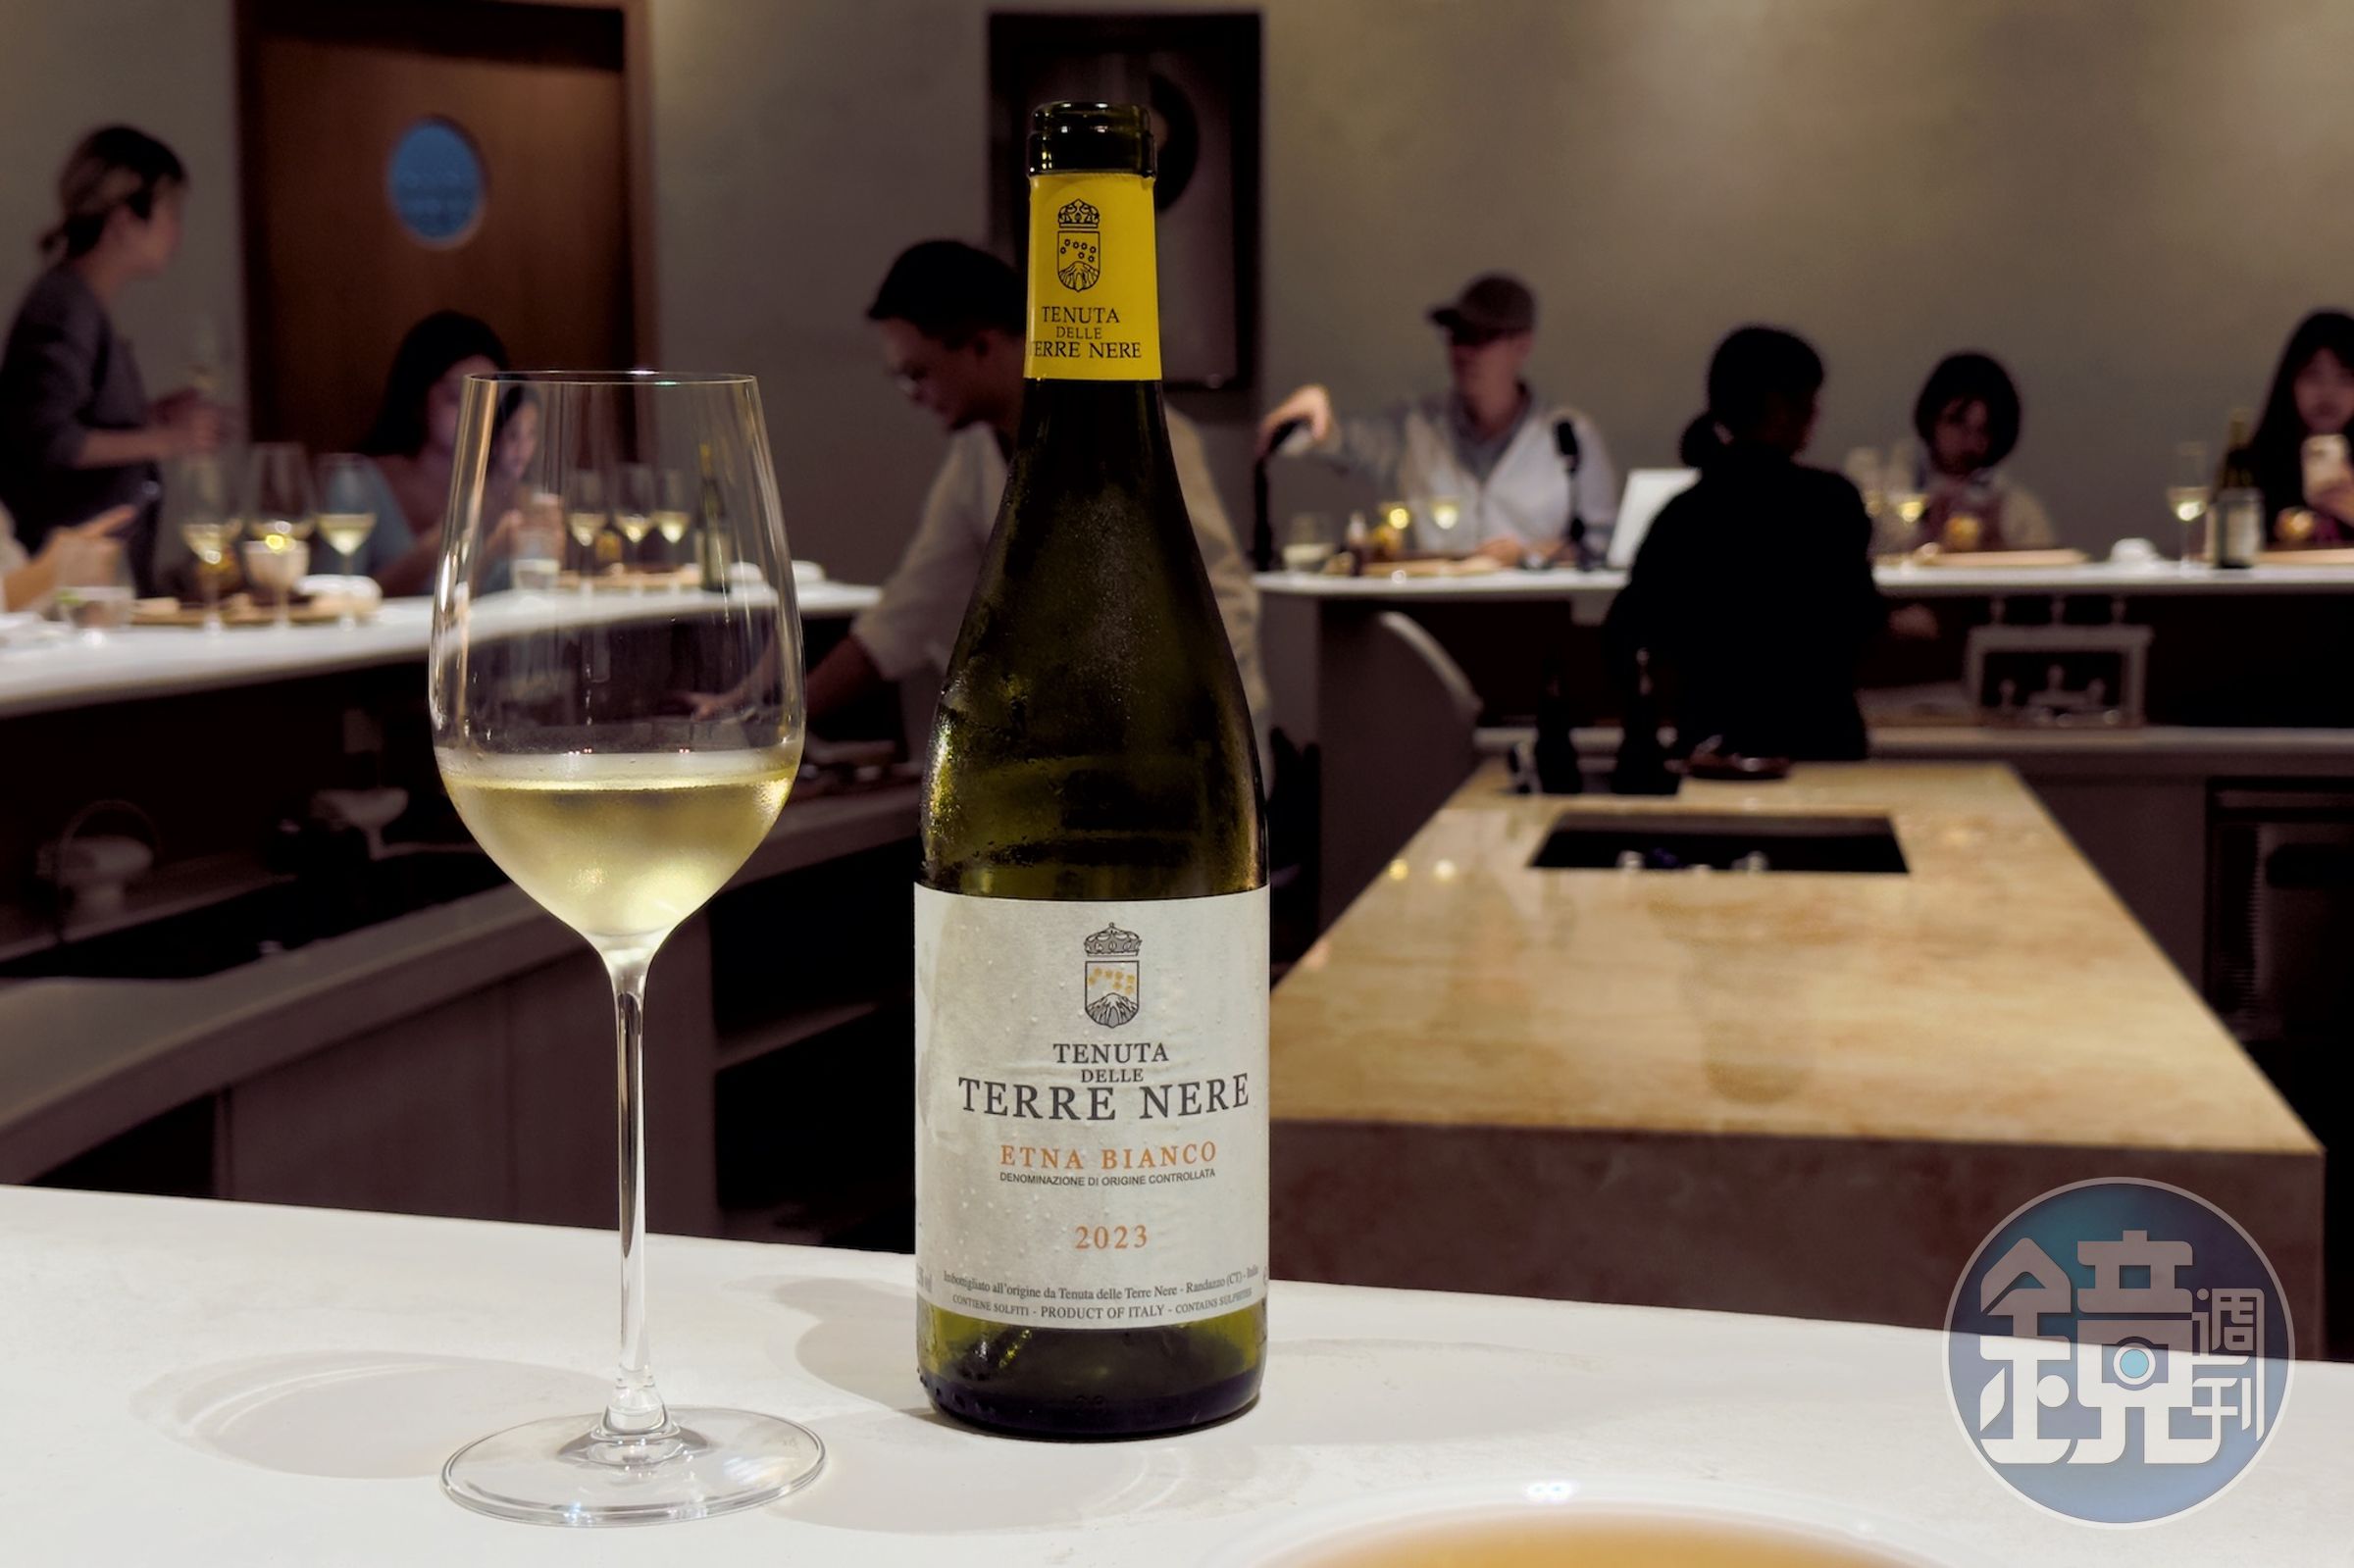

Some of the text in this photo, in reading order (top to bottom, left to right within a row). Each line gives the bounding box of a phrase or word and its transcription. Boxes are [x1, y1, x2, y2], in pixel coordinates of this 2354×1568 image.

[1042, 306, 1120, 324] TENUTA
[1056, 326, 1102, 340] DELLE
[1030, 340, 1142, 359] ERRE NERE
[1052, 1042, 1169, 1064] TENUTA
[1080, 1068, 1144, 1084] DELLE
[958, 1073, 1250, 1121] TERRE NERE
[1000, 1140, 1217, 1170] ETNA BIANCO
[999, 1168, 1216, 1187] DENOMINAZIONE DI ORIGINE CONTROLLATA
[1075, 1224, 1149, 1249] 2023
[1043, 1287, 1056, 1299] da
[1058, 1287, 1095, 1300] Tenuta
[1096, 1288, 1123, 1300] delle
[1124, 1287, 1151, 1299] Terre
[1153, 1286, 1178, 1297] Nere
[1186, 1279, 1226, 1293] Randazzo
[952, 1293, 992, 1312] CONTIENE
[993, 1302, 1030, 1317] SOLFITI
[1041, 1305, 1104, 1320] PRODUCT
[1106, 1306, 1125, 1320] OF
[1128, 1303, 1165, 1319] ITALY
[1175, 1296, 1218, 1315] CONTAINS
